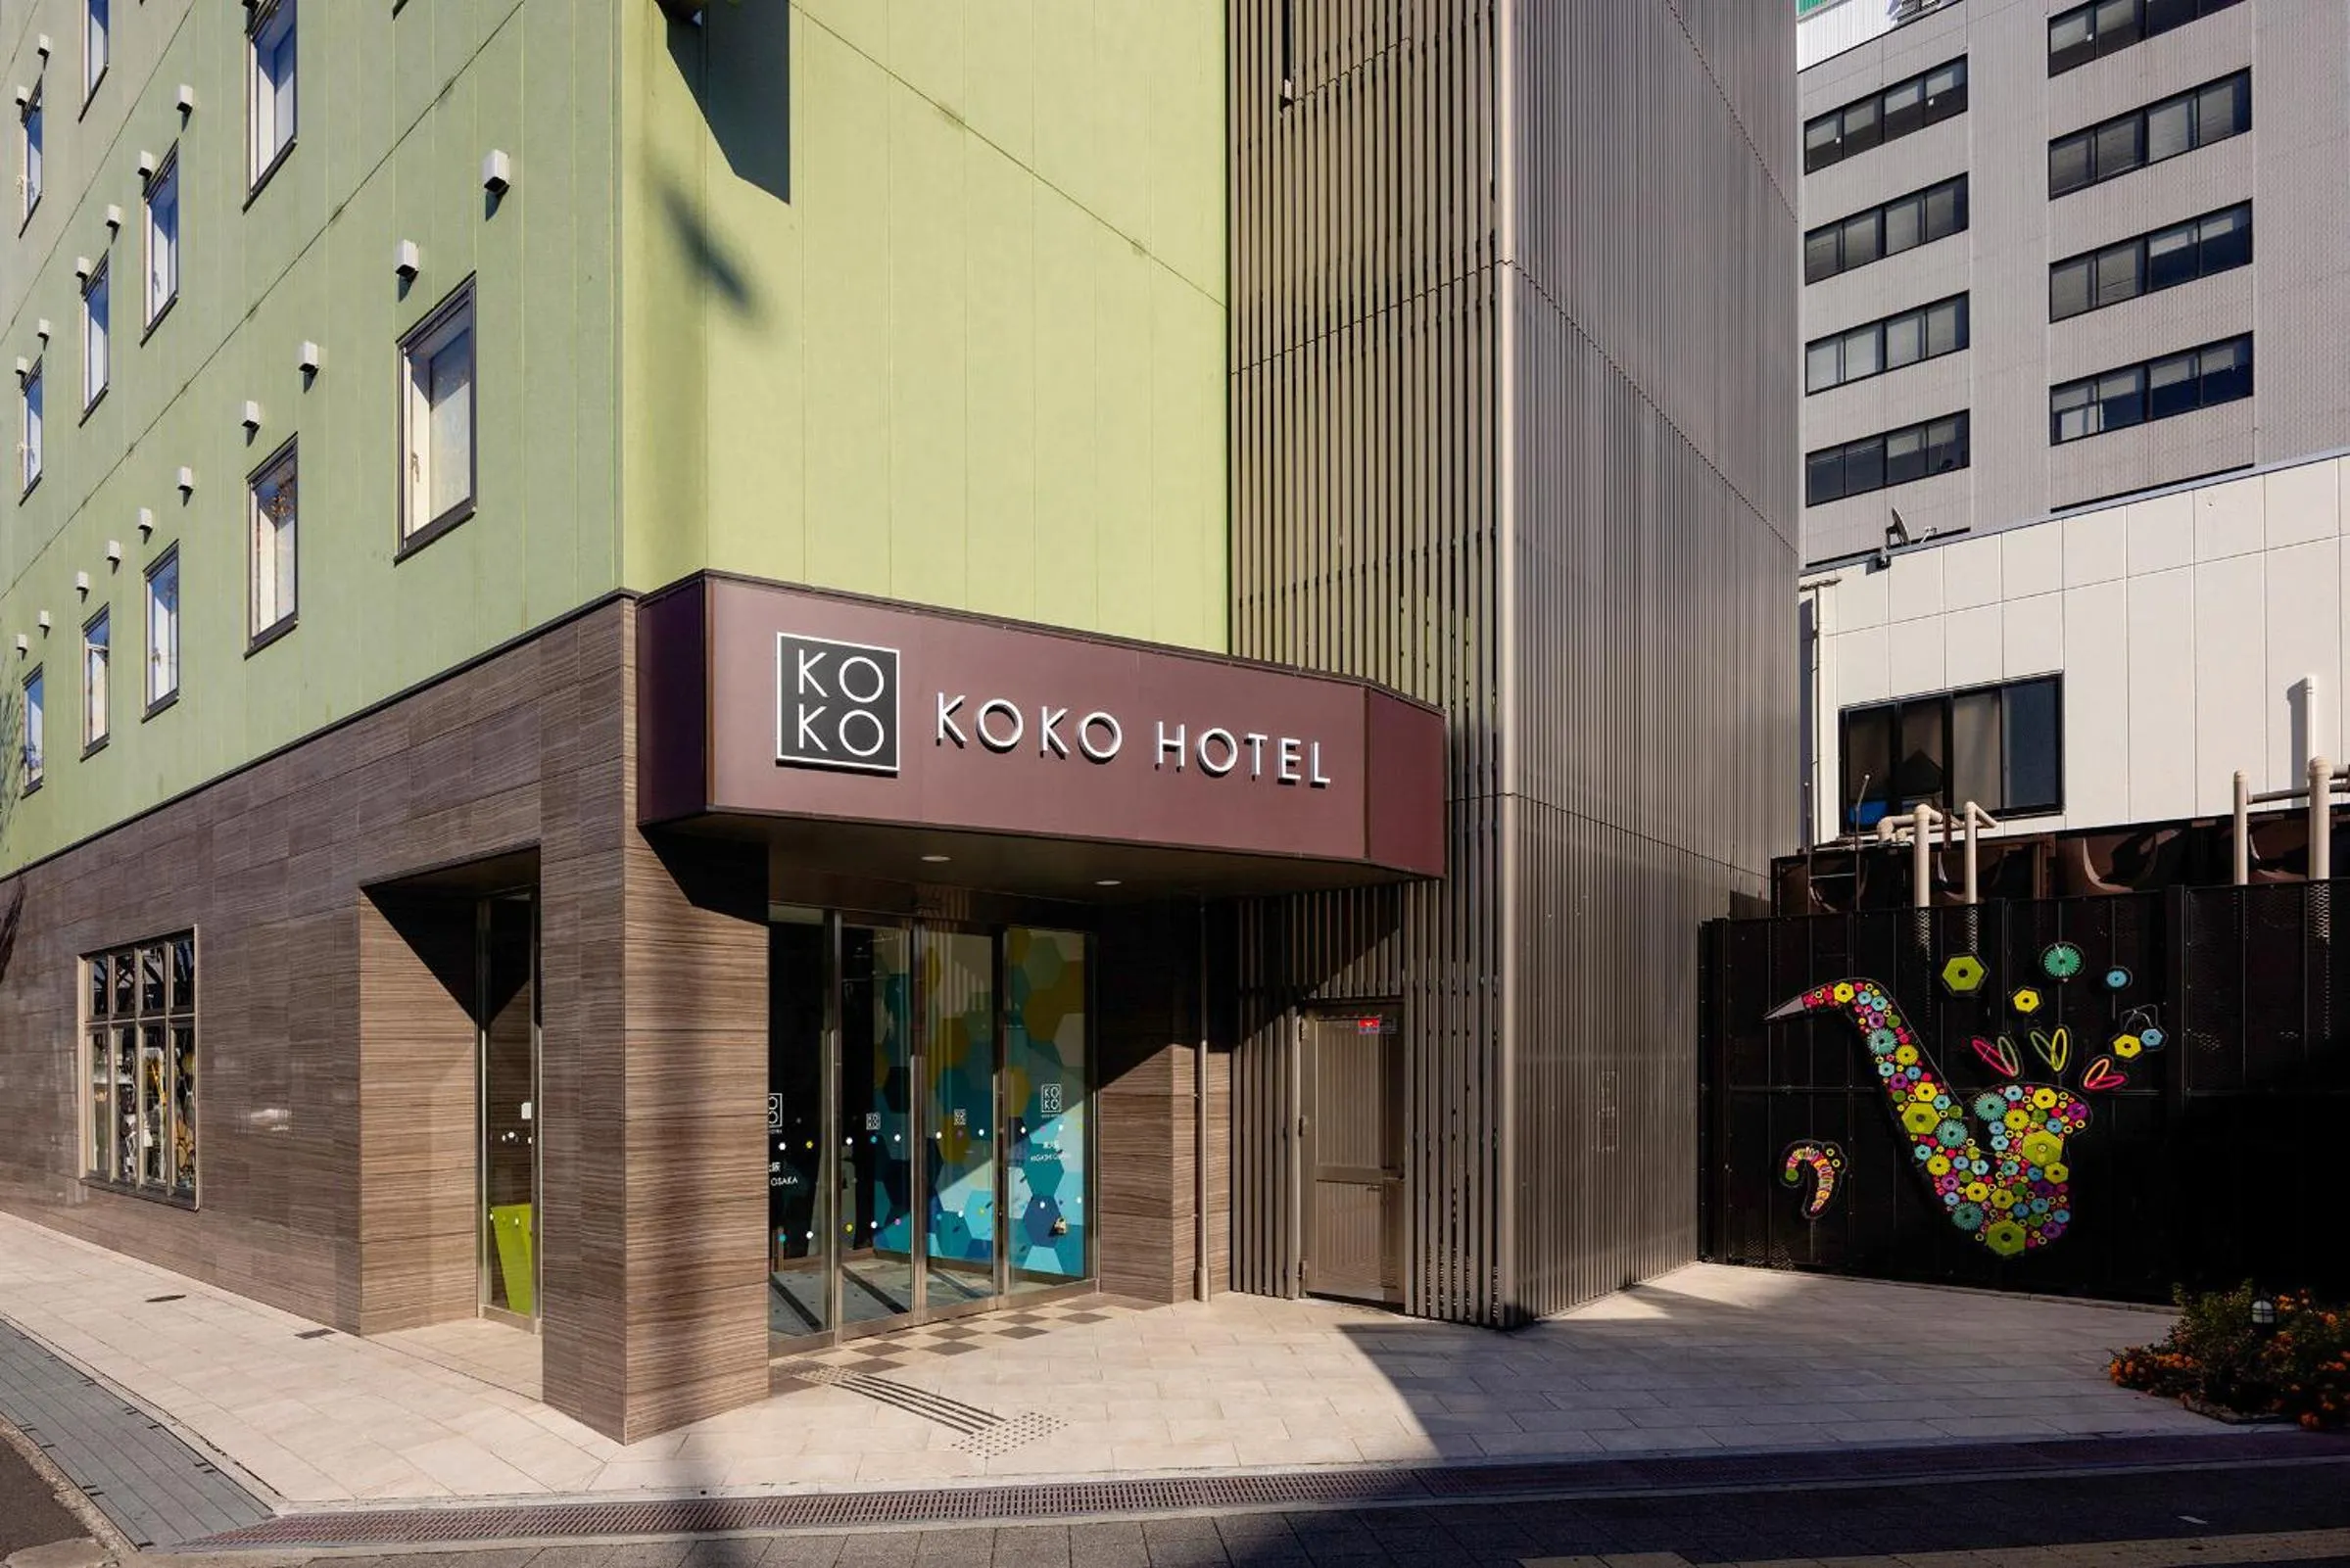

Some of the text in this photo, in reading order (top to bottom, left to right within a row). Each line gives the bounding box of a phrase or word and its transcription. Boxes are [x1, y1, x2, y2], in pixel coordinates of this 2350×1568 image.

[798, 648, 885, 703] KO
[798, 702, 885, 756] KO
[936, 691, 1331, 784] KOKO HOTEL
